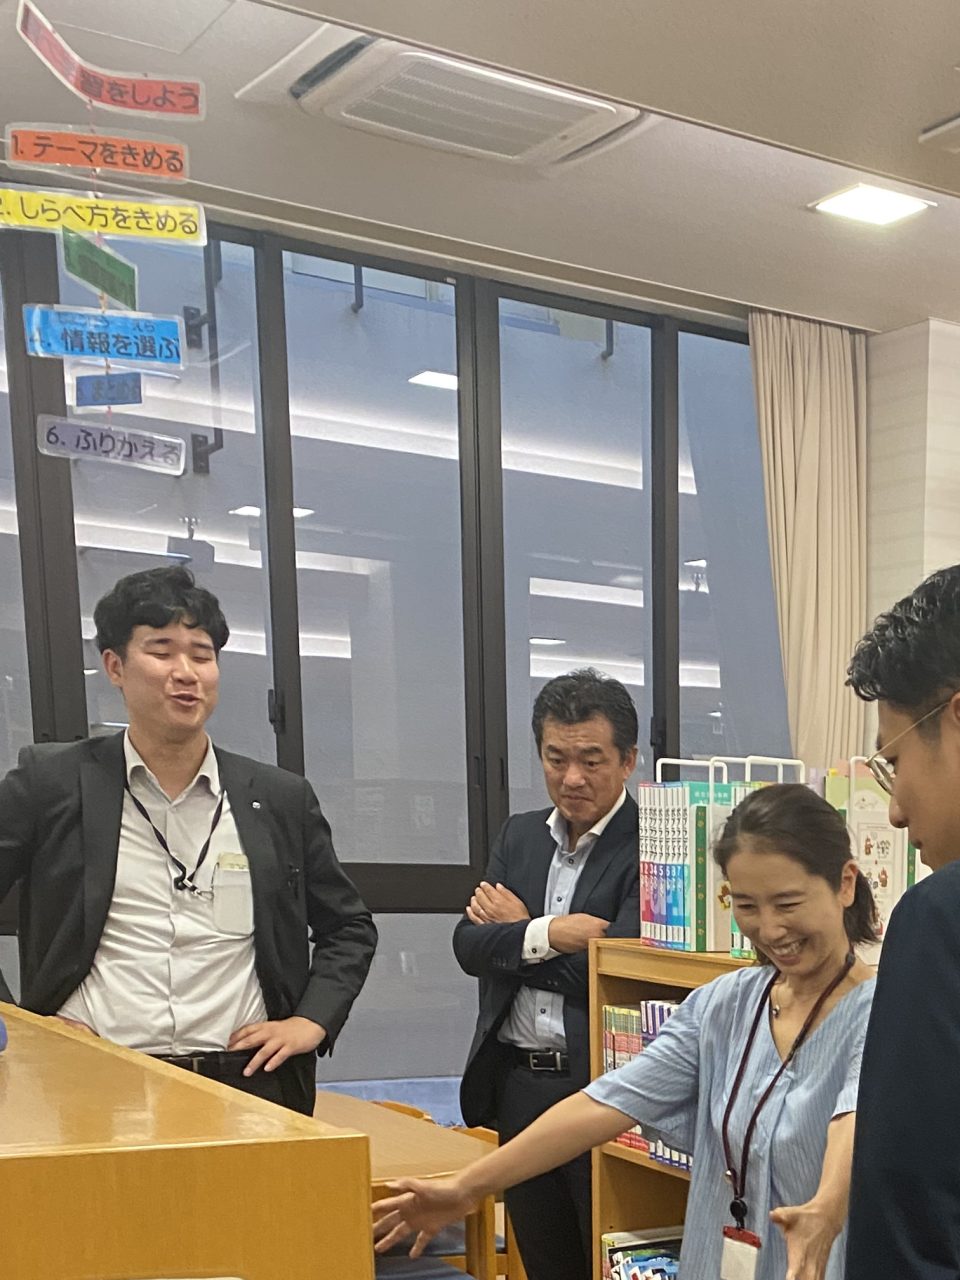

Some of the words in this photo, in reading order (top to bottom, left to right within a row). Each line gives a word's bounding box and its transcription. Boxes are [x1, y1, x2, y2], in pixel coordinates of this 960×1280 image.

[33, 136, 184, 173] テーマをきめる
[20, 196, 198, 234] しらべ方をきめる
[61, 328, 180, 359] 情報を選ぶ
[75, 429, 181, 464] ふりかえる
